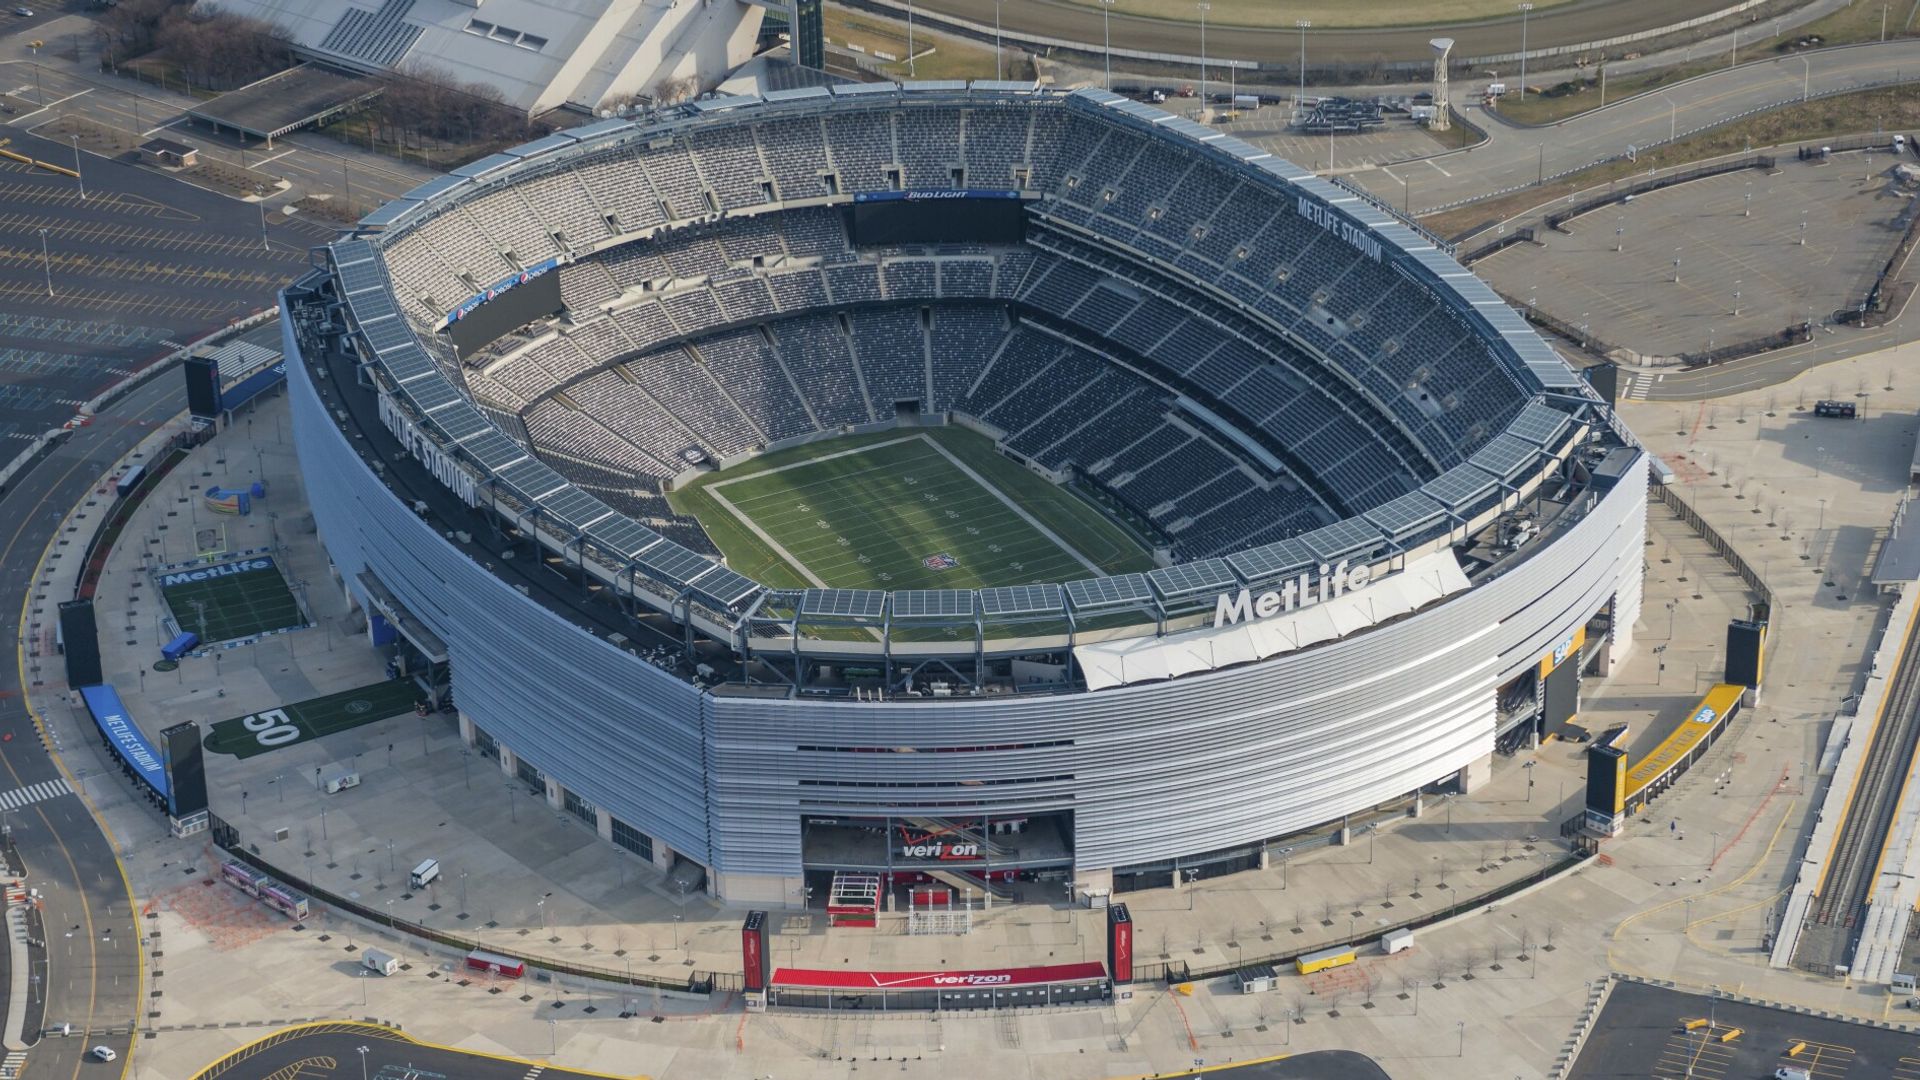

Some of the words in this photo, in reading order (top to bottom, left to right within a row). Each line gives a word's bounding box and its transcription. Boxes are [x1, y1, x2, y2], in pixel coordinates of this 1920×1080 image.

[934, 191, 968, 199] LIGHT
[1298, 196, 1340, 236] METLIFE
[1341, 222, 1382, 264] STADIUM
[422, 441, 478, 508] STADIUM
[165, 560, 269, 586] MetLife
[1214, 560, 1370, 628] MetLife
[104, 714, 137, 745] METLIFE
[125, 742, 162, 772] STADIUM
[243, 708, 300, 746] 50
[903, 841, 978, 859] verizon
[934, 974, 1011, 984] verizon
